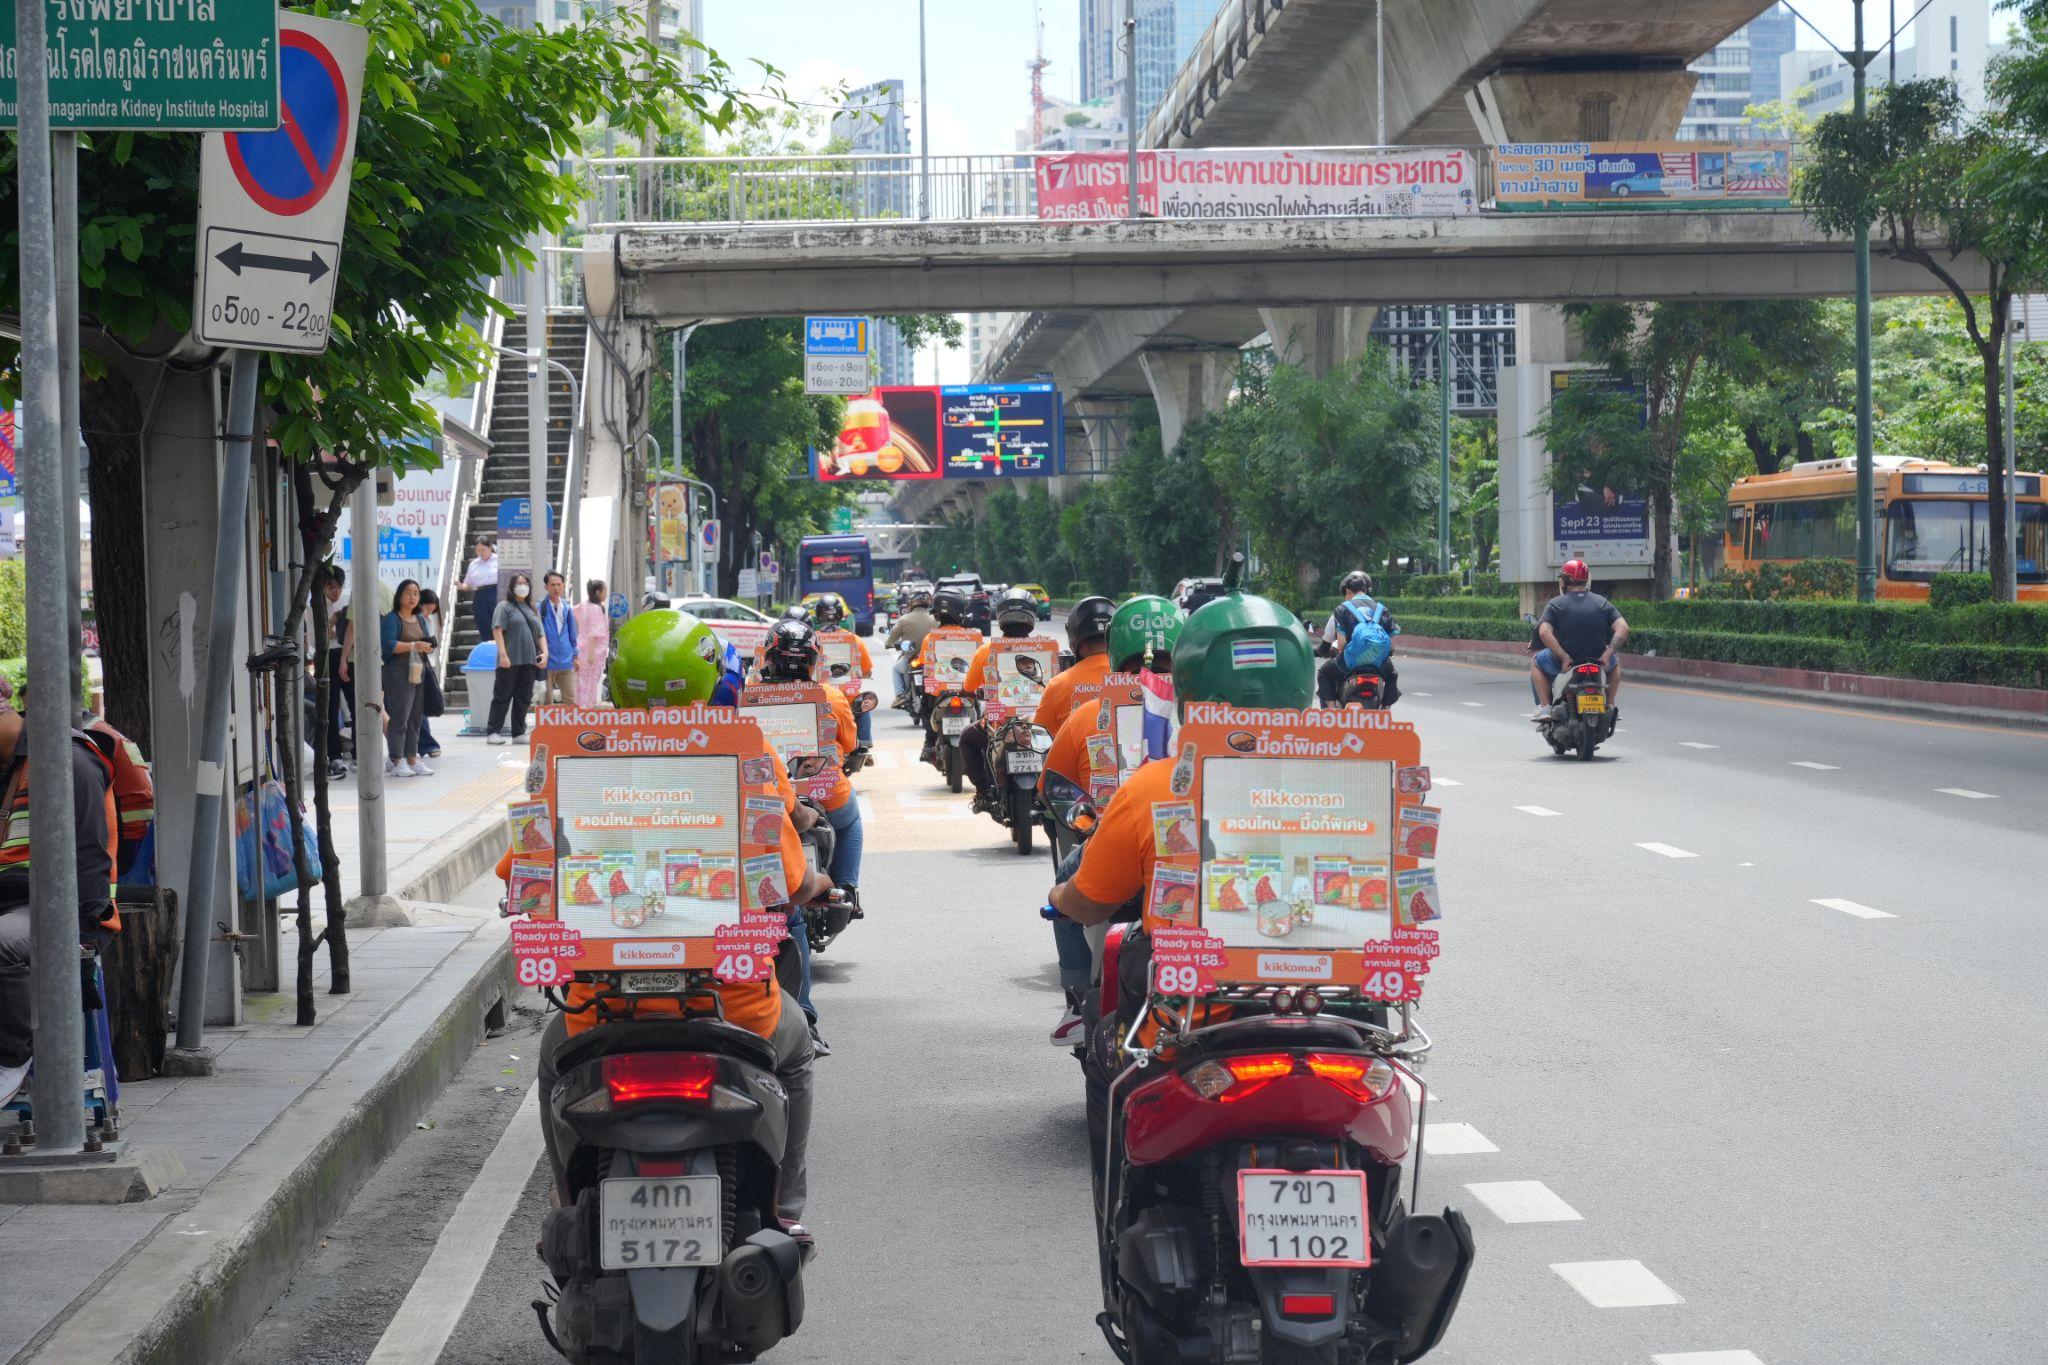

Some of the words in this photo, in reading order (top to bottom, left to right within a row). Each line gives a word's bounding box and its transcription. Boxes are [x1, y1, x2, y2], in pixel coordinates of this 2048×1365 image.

[121, 100, 163, 121] Kidney
[166, 100, 216, 118] Institute
[219, 100, 269, 119] Hospital
[1534, 158, 1555, 173] 30
[1560, 160, 1595, 173] เมตร
[1038, 162, 1070, 191] 17
[1074, 160, 1154, 187] มกราม
[1500, 177, 1579, 194] ทางม้าลาย
[1561, 517, 1584, 530] Sept
[1586, 516, 1600, 526] 23
[381, 567, 415, 577] PARK
[1129, 614, 1175, 630] Grab
[538, 708, 646, 726] Kikkoman
[1187, 705, 1299, 727] Kikkoman
[606, 729, 689, 752] มื้อก็พิเศษ
[1256, 730, 1342, 756] มื้อก็พิเศษ
[603, 787, 693, 803] Kikkoman
[1250, 789, 1344, 808] Kikkoman
[514, 932, 547, 942] Ready
[549, 932, 560, 940] to
[562, 931, 579, 940] Eat
[1155, 938, 1188, 950] Ready
[1191, 938, 1202, 948] to
[1204, 938, 1222, 949] Eat
[620, 949, 675, 960] kikkoman
[1264, 962, 1321, 973] kikkoman
[630, 1184, 692, 1208] 4กก
[1269, 1180, 1336, 1204] 7ขว
[609, 1216, 714, 1237] กรุงเทพมหานคร
[1246, 1212, 1358, 1231] กรุงเทพมหานคร
[621, 1238, 702, 1263] 5172
[1268, 1235, 1349, 1259] 1102
